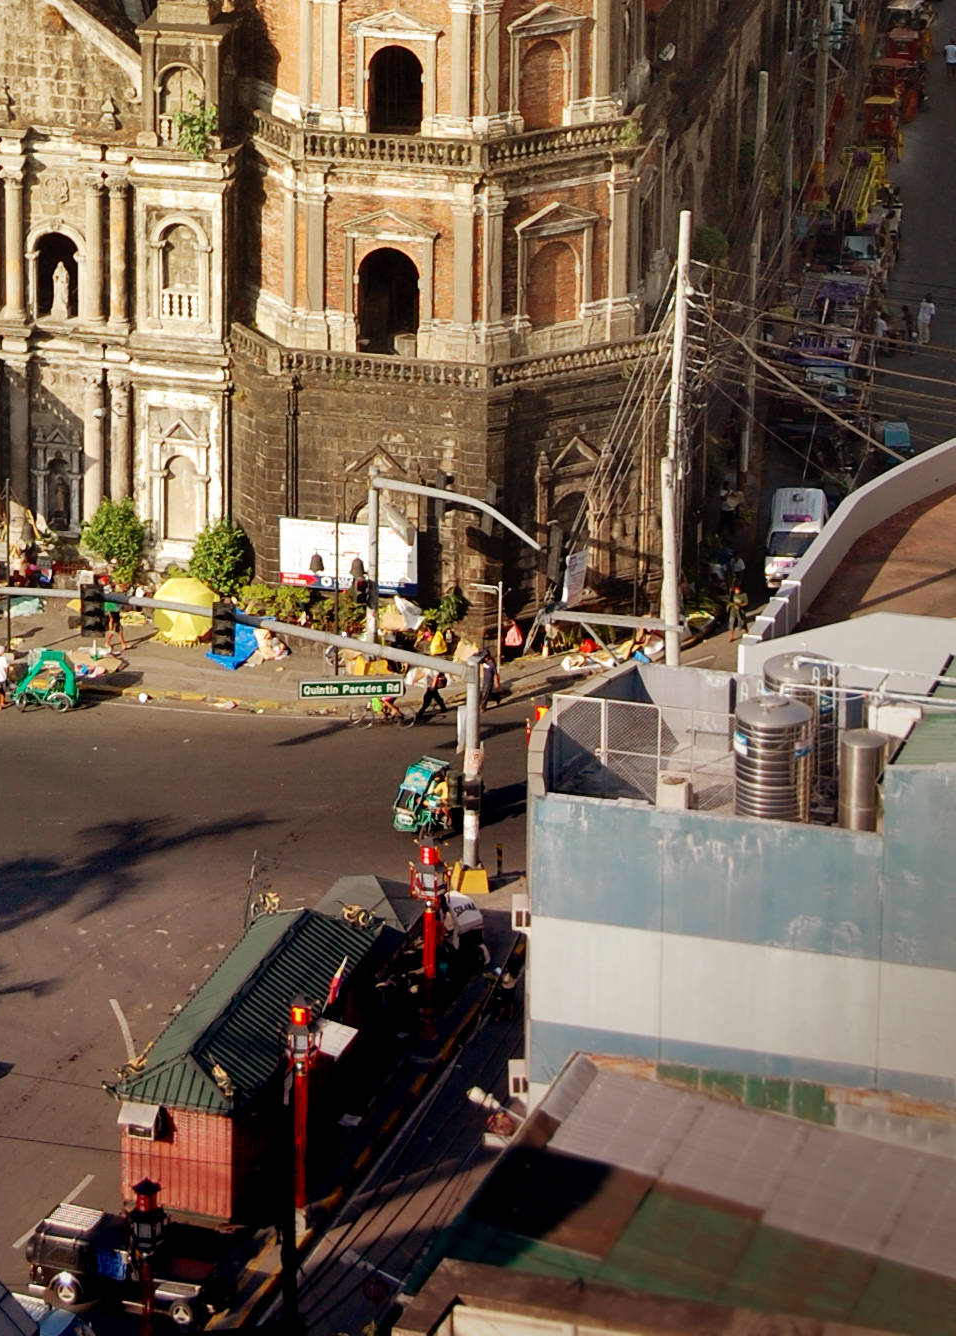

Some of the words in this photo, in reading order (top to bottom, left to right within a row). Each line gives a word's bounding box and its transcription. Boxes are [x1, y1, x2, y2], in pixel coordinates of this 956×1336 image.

[303, 685, 339, 696] Quintin
[342, 684, 383, 694] Paredes
[386, 683, 400, 693] Rd
